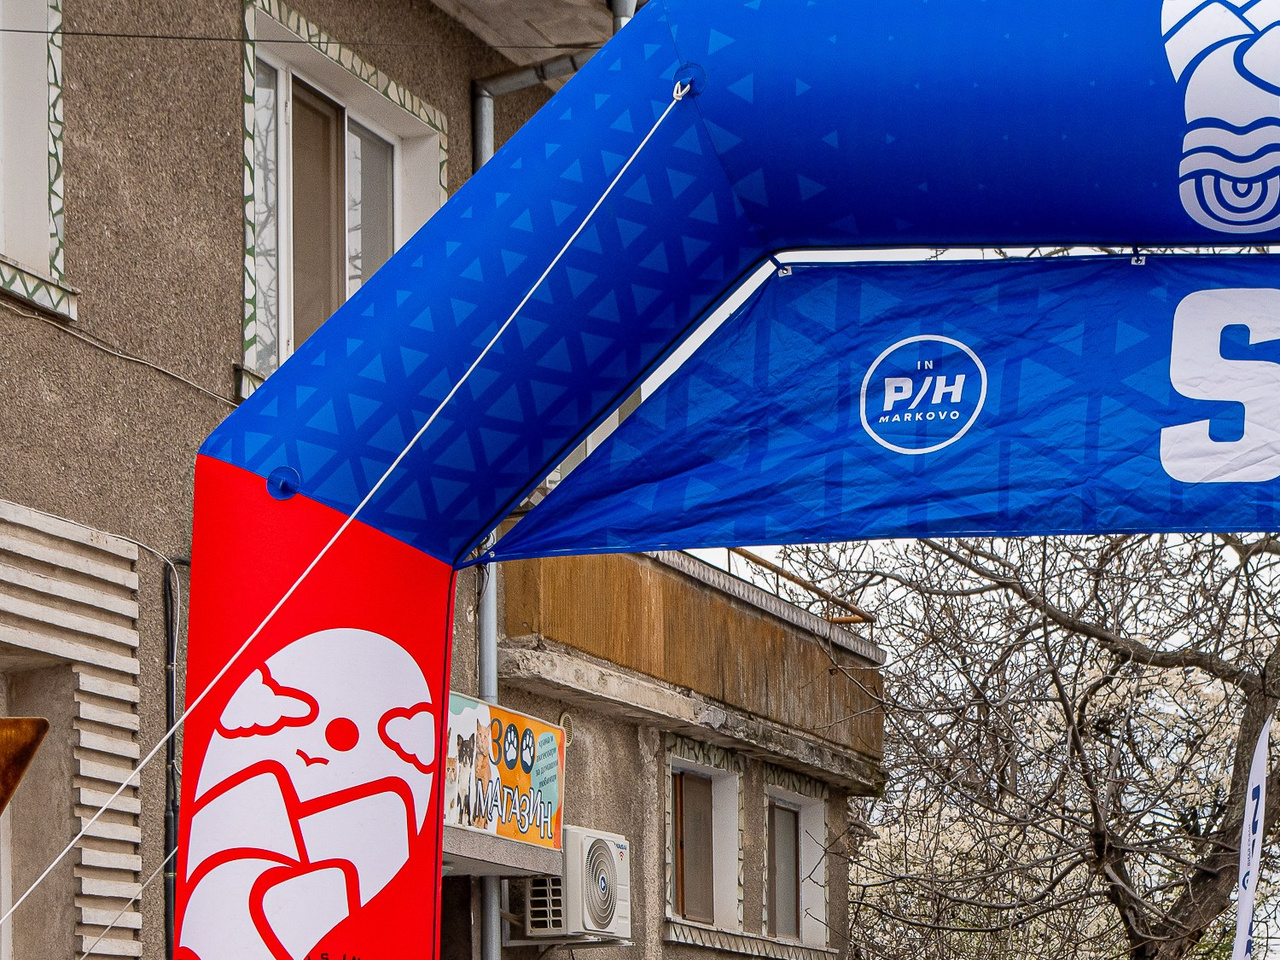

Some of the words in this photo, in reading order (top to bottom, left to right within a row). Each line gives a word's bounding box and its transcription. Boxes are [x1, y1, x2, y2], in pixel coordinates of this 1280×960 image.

[917, 360, 933, 370] IN
[883, 374, 966, 412] P/H
[879, 411, 960, 423] MARKOVO
[475, 777, 553, 839] МАГАЗИН
